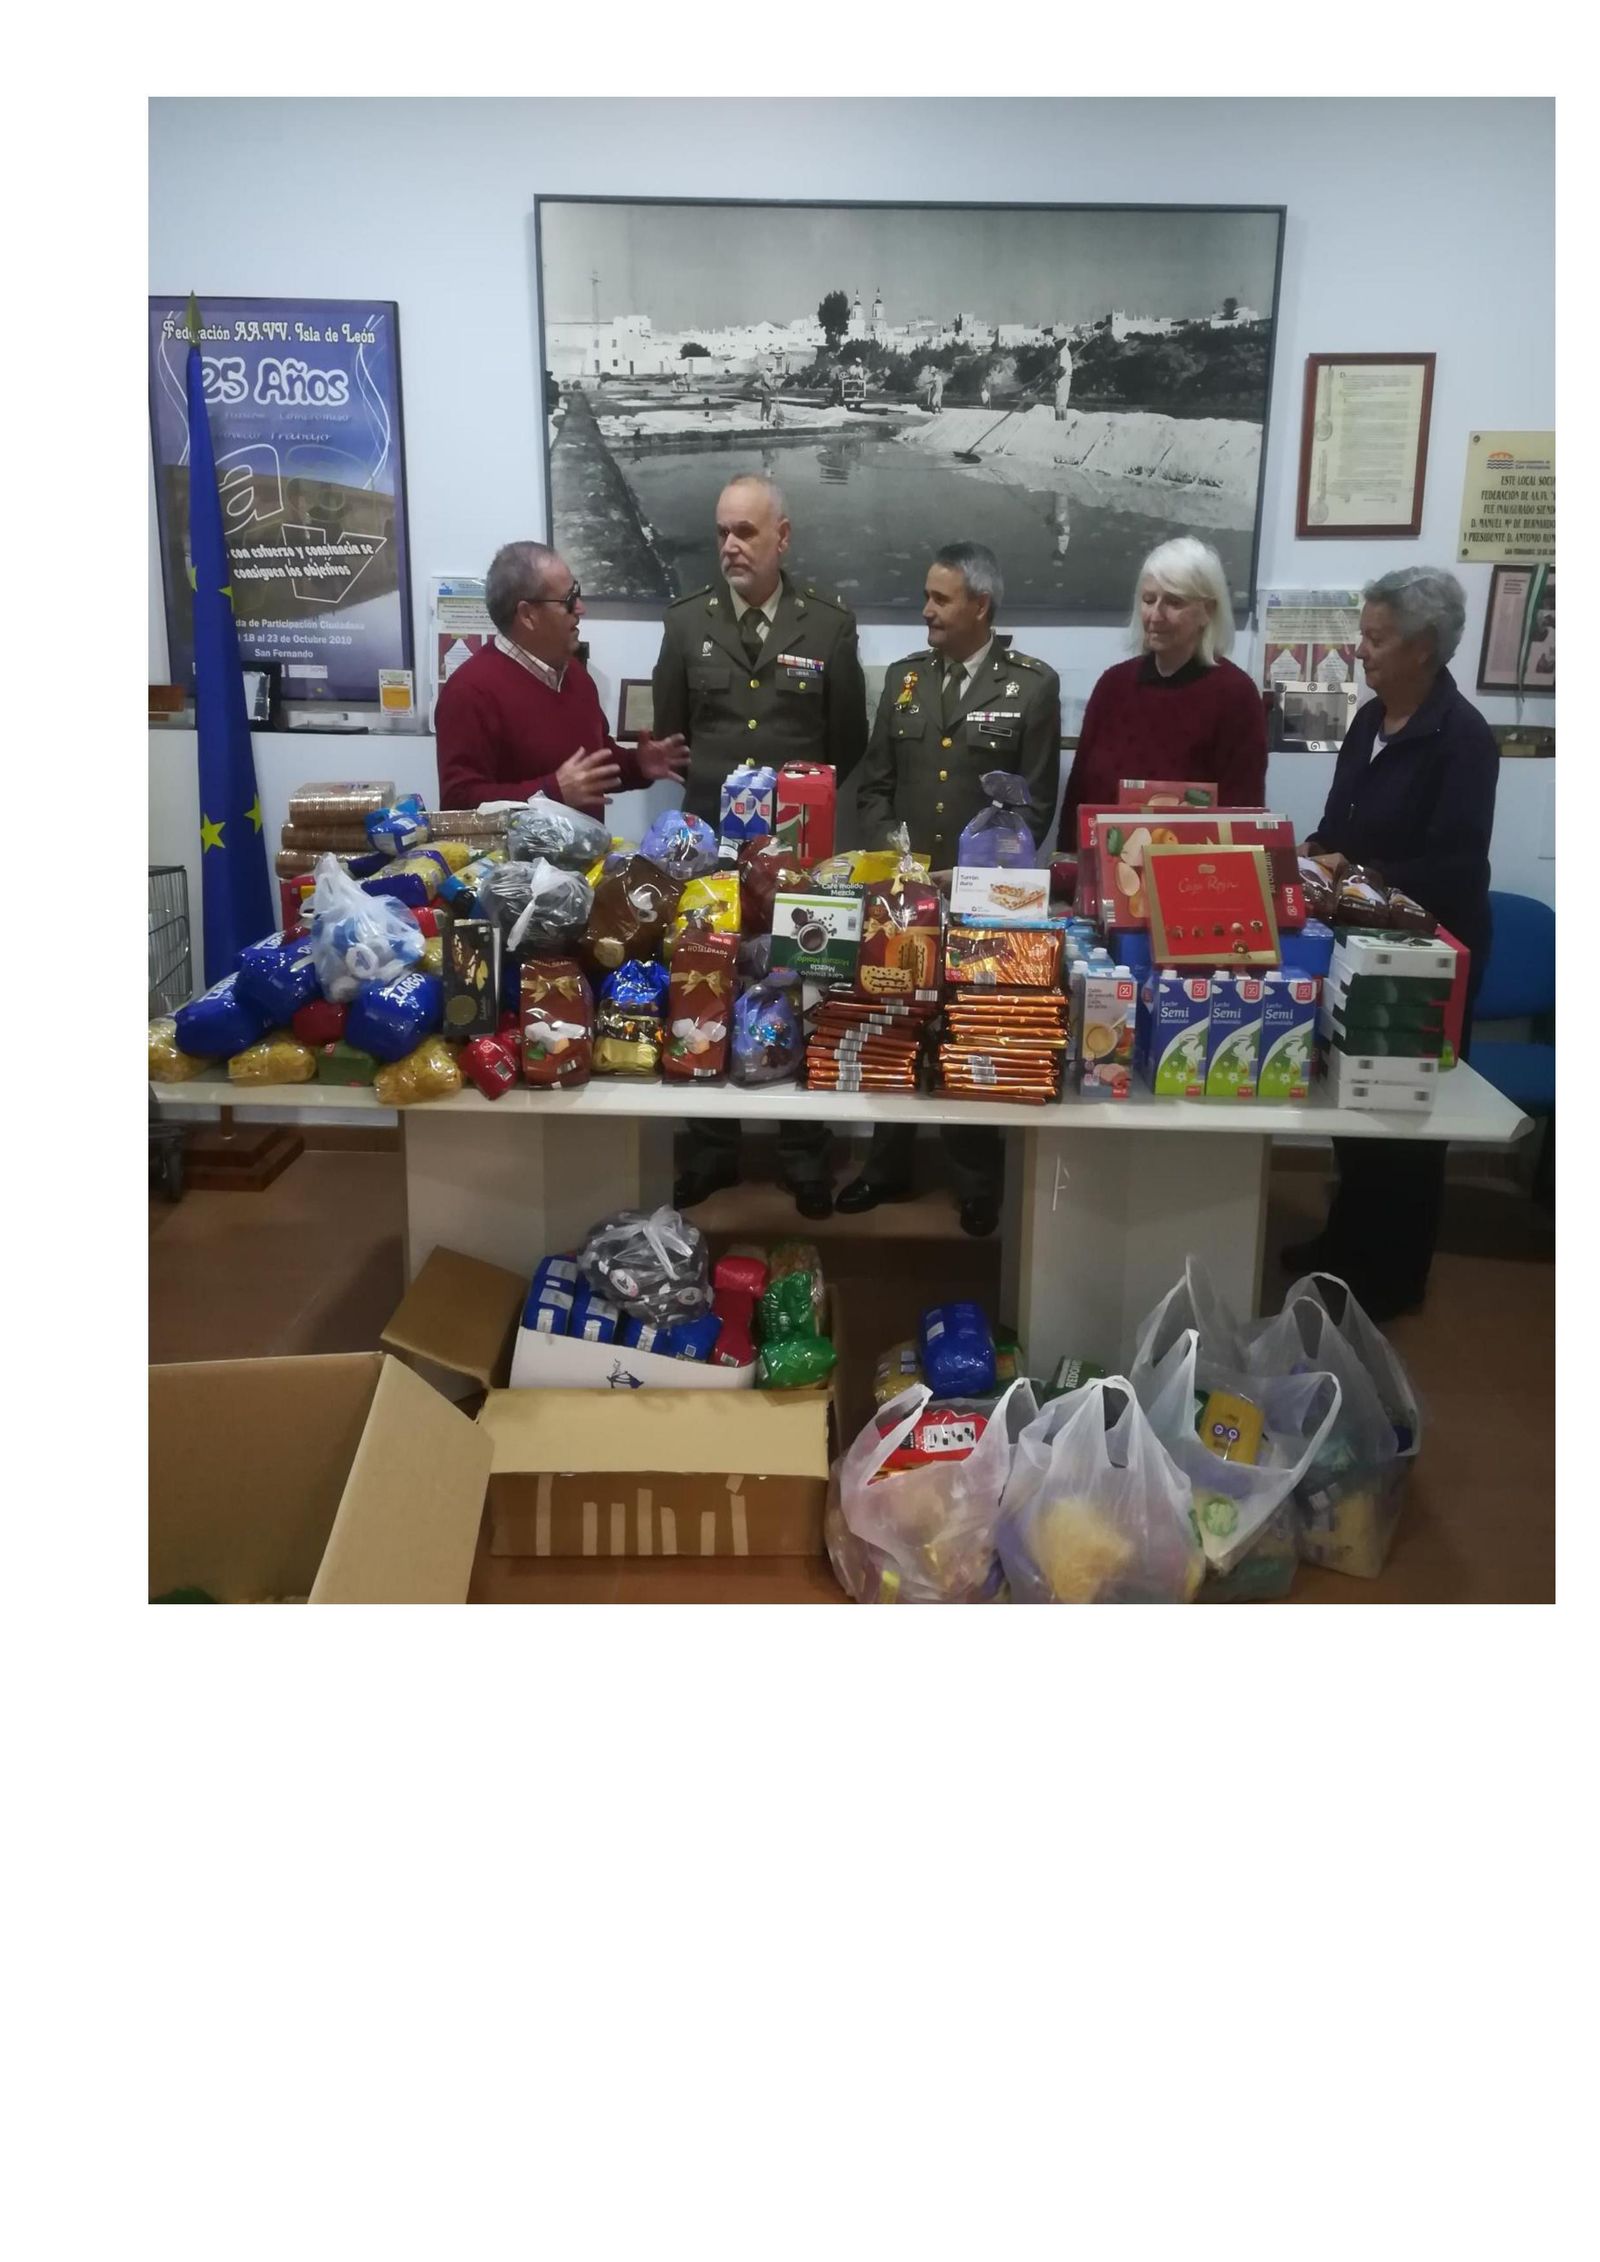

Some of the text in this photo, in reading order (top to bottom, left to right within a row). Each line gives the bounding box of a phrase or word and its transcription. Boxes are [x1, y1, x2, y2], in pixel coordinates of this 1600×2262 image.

[162, 319, 231, 342] Fedación
[295, 322, 321, 342] Isla
[325, 327, 338, 343] de
[342, 323, 375, 344] León
[254, 357, 350, 407] Años
[1501, 475, 1516, 486] ESTE
[1517, 475, 1536, 486] LOCAL
[1521, 491, 1529, 501] DE
[1479, 518, 1502, 528] MANUEL
[1468, 532, 1505, 543] PRESIDENTE
[1515, 533, 1541, 543] ANTONIO
[231, 541, 374, 560] con esfuerzo y constancia se
[233, 561, 351, 581] consiguen los objetivos
[249, 619, 260, 628] de
[257, 634, 265, 643] al
[266, 634, 279, 643] 23
[280, 635, 291, 644] de
[292, 634, 327, 644] Octubre
[254, 649, 313, 659] San Fernando
[831, 889, 855, 897] Mezcla
[1161, 1007, 1189, 1018] Semi
[1213, 1008, 1241, 1019] Semi
[1265, 1009, 1293, 1020] Semi
